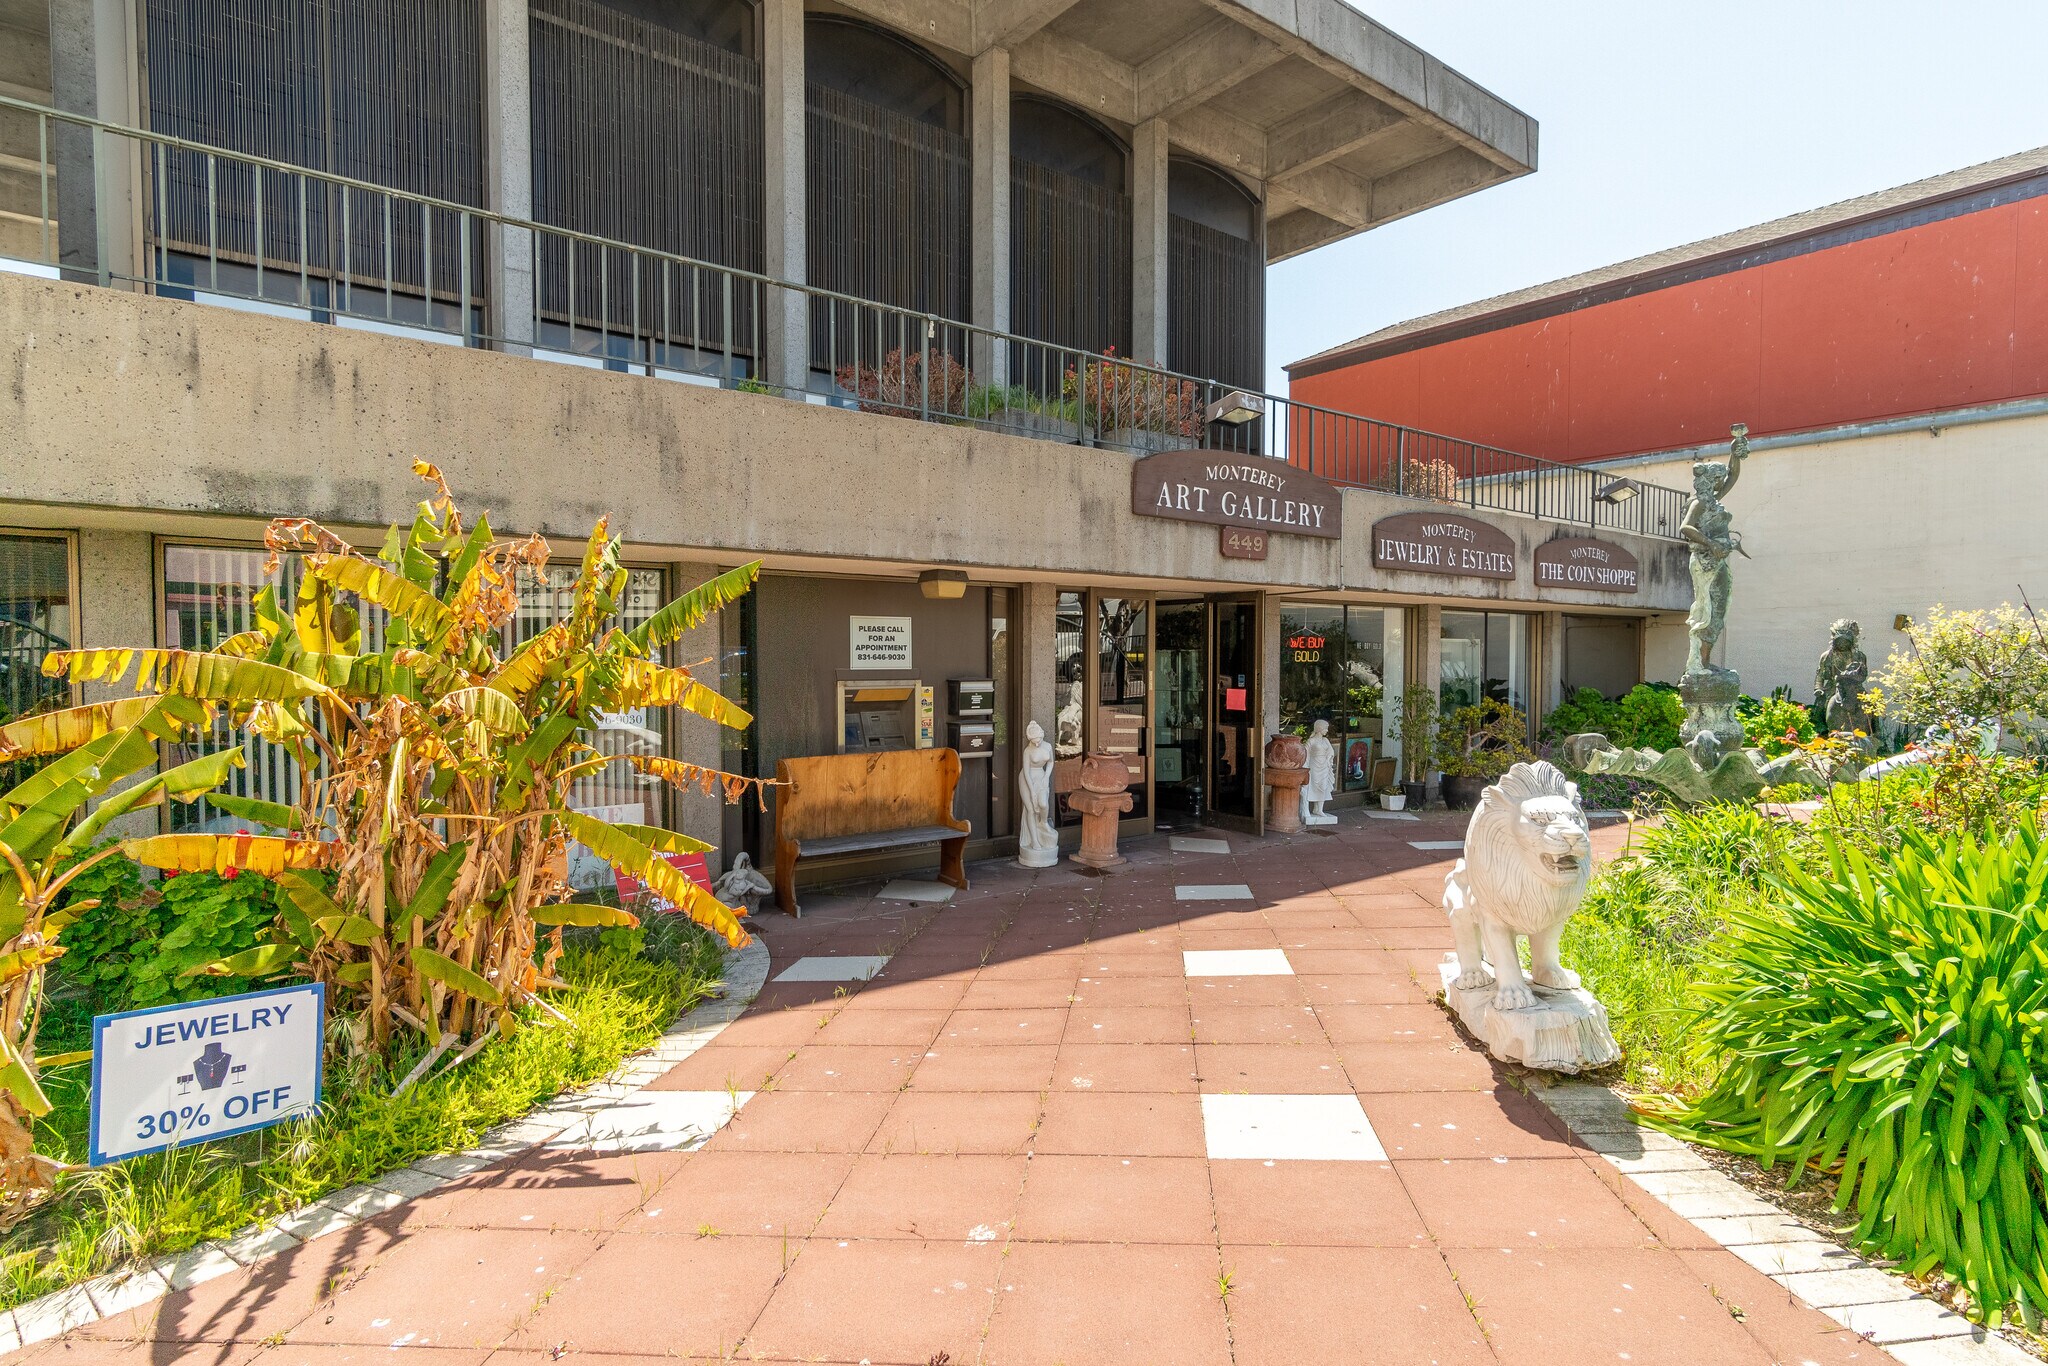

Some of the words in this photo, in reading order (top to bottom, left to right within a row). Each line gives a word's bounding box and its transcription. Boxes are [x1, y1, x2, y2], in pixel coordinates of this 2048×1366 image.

[1205, 463, 1286, 493] MONTEREY
[1156, 481, 1210, 513] ART
[1221, 491, 1325, 528] GALLERY
[1228, 532, 1264, 552] 449
[1421, 523, 1477, 543] MONTEREY
[1378, 539, 1442, 566] JEWELRY
[1447, 547, 1456, 567] &
[1462, 548, 1513, 573] ESTATES
[1570, 546, 1611, 564] MONTEREY
[1539, 562, 1564, 580] THE
[1567, 564, 1595, 583] COIN
[1596, 566, 1637, 586] SHOPPE
[858, 625, 886, 633] PLEASE
[886, 625, 905, 633] CALL
[1290, 636, 1306, 648] WE
[1307, 636, 1326, 648] BUY
[857, 653, 906, 661] 831-646-9030
[1294, 650, 1320, 663] GOLD
[134, 1003, 293, 1049] JEWELRY
[136, 1102, 211, 1140] 30%
[223, 1085, 292, 1119] OFF
